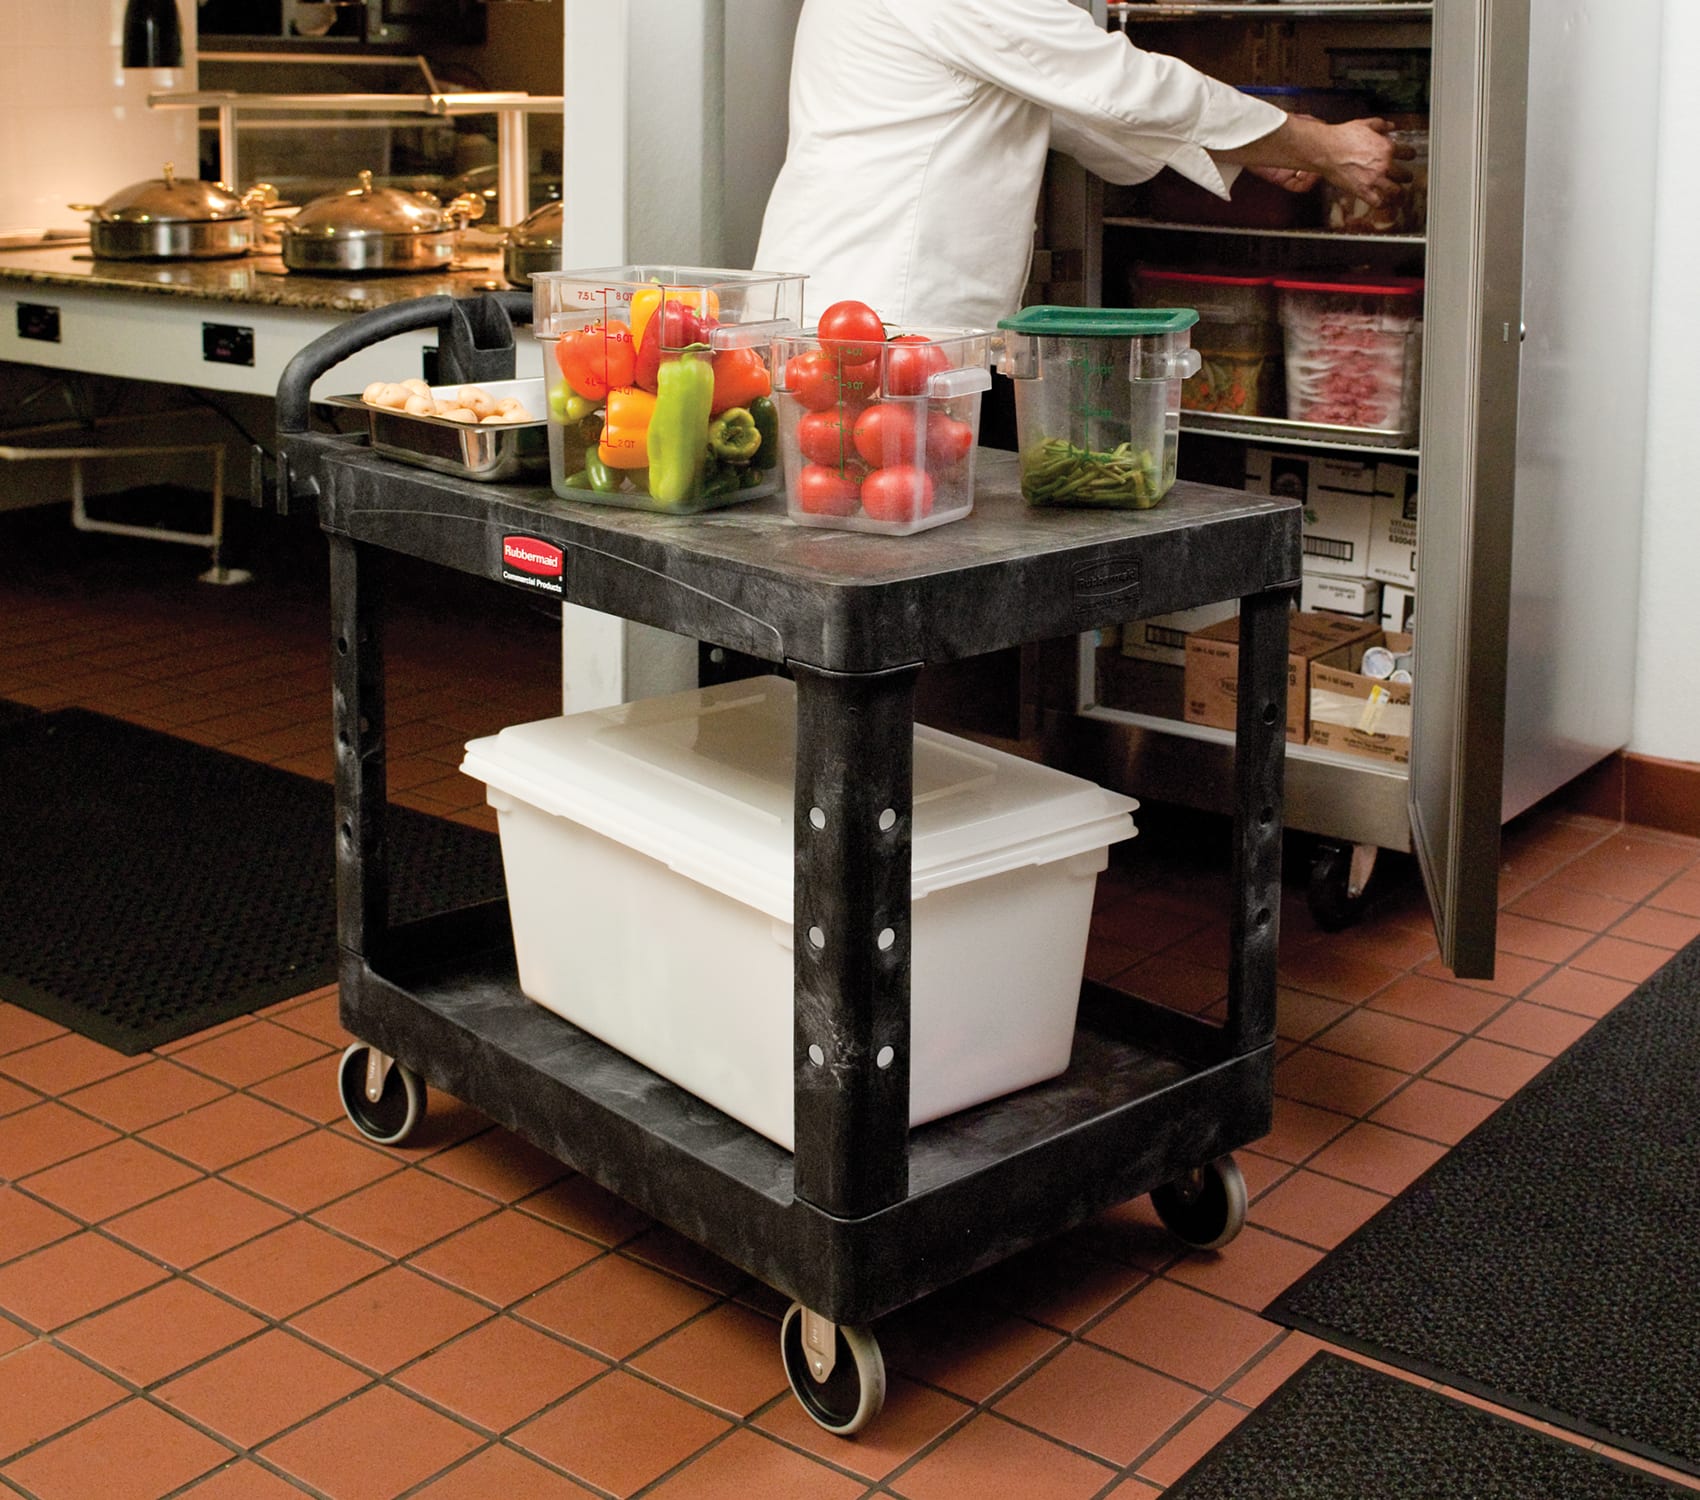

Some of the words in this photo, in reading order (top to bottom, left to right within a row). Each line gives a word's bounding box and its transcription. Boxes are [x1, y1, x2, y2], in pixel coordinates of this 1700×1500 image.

[622, 292, 634, 302] QT
[624, 439, 635, 448] QT
[504, 544, 558, 568] Rubbermaid
[503, 570, 536, 586] Commercial
[536, 579, 562, 593] Products
